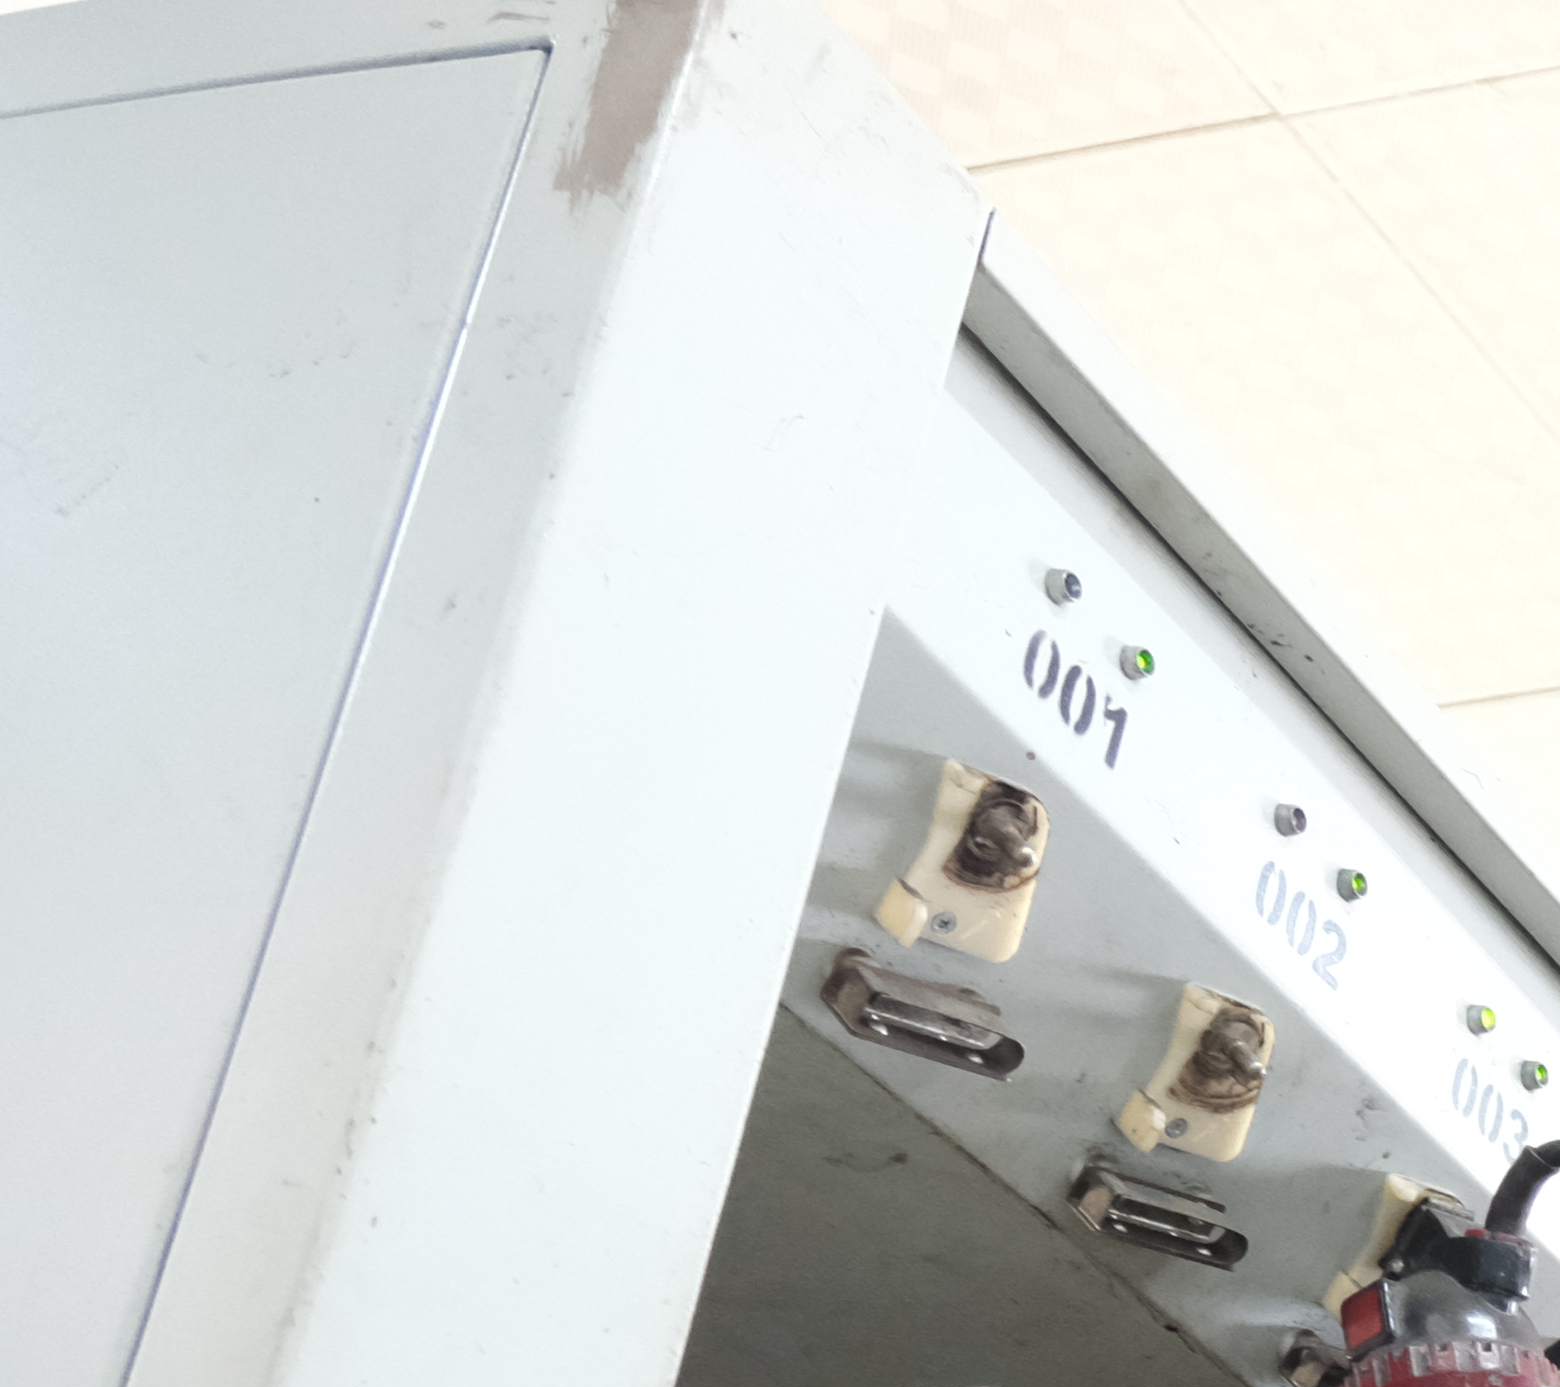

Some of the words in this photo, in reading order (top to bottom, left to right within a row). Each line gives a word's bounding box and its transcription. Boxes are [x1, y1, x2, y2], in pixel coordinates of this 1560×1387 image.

[1023, 629, 1128, 769] 001
[1255, 861, 1349, 991] 002
[1450, 1058, 1530, 1168] 003
